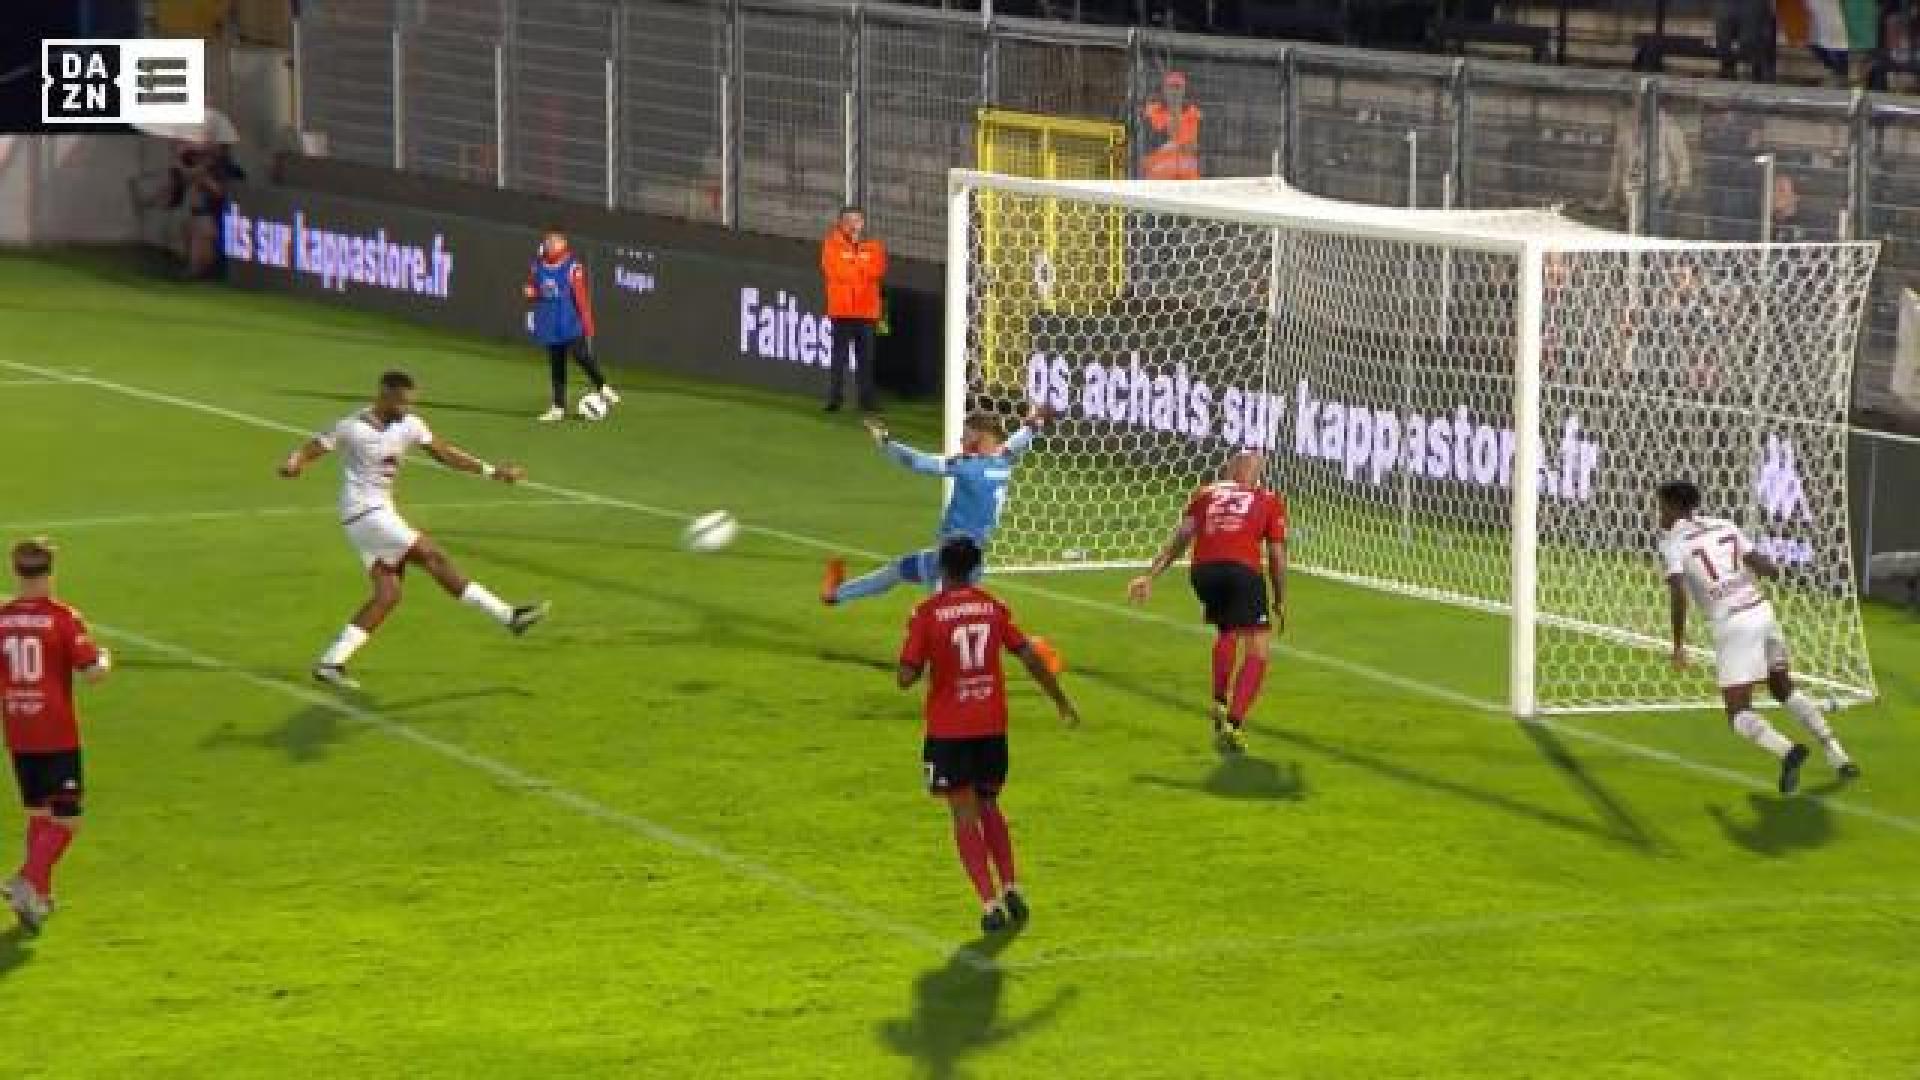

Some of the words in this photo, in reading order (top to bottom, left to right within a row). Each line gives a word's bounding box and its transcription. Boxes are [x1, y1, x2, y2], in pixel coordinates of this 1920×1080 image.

[257, 220, 291, 267] sur
[294, 210, 453, 301] kappastore.fr
[741, 287, 834, 370] Faites
[1083, 350, 1213, 438] achats
[1223, 386, 1285, 451] sur
[1296, 381, 1600, 502] kappastor.fr
[1692, 533, 1738, 582] 17
[3, 635, 43, 684] 10
[951, 623, 991, 670] 17
